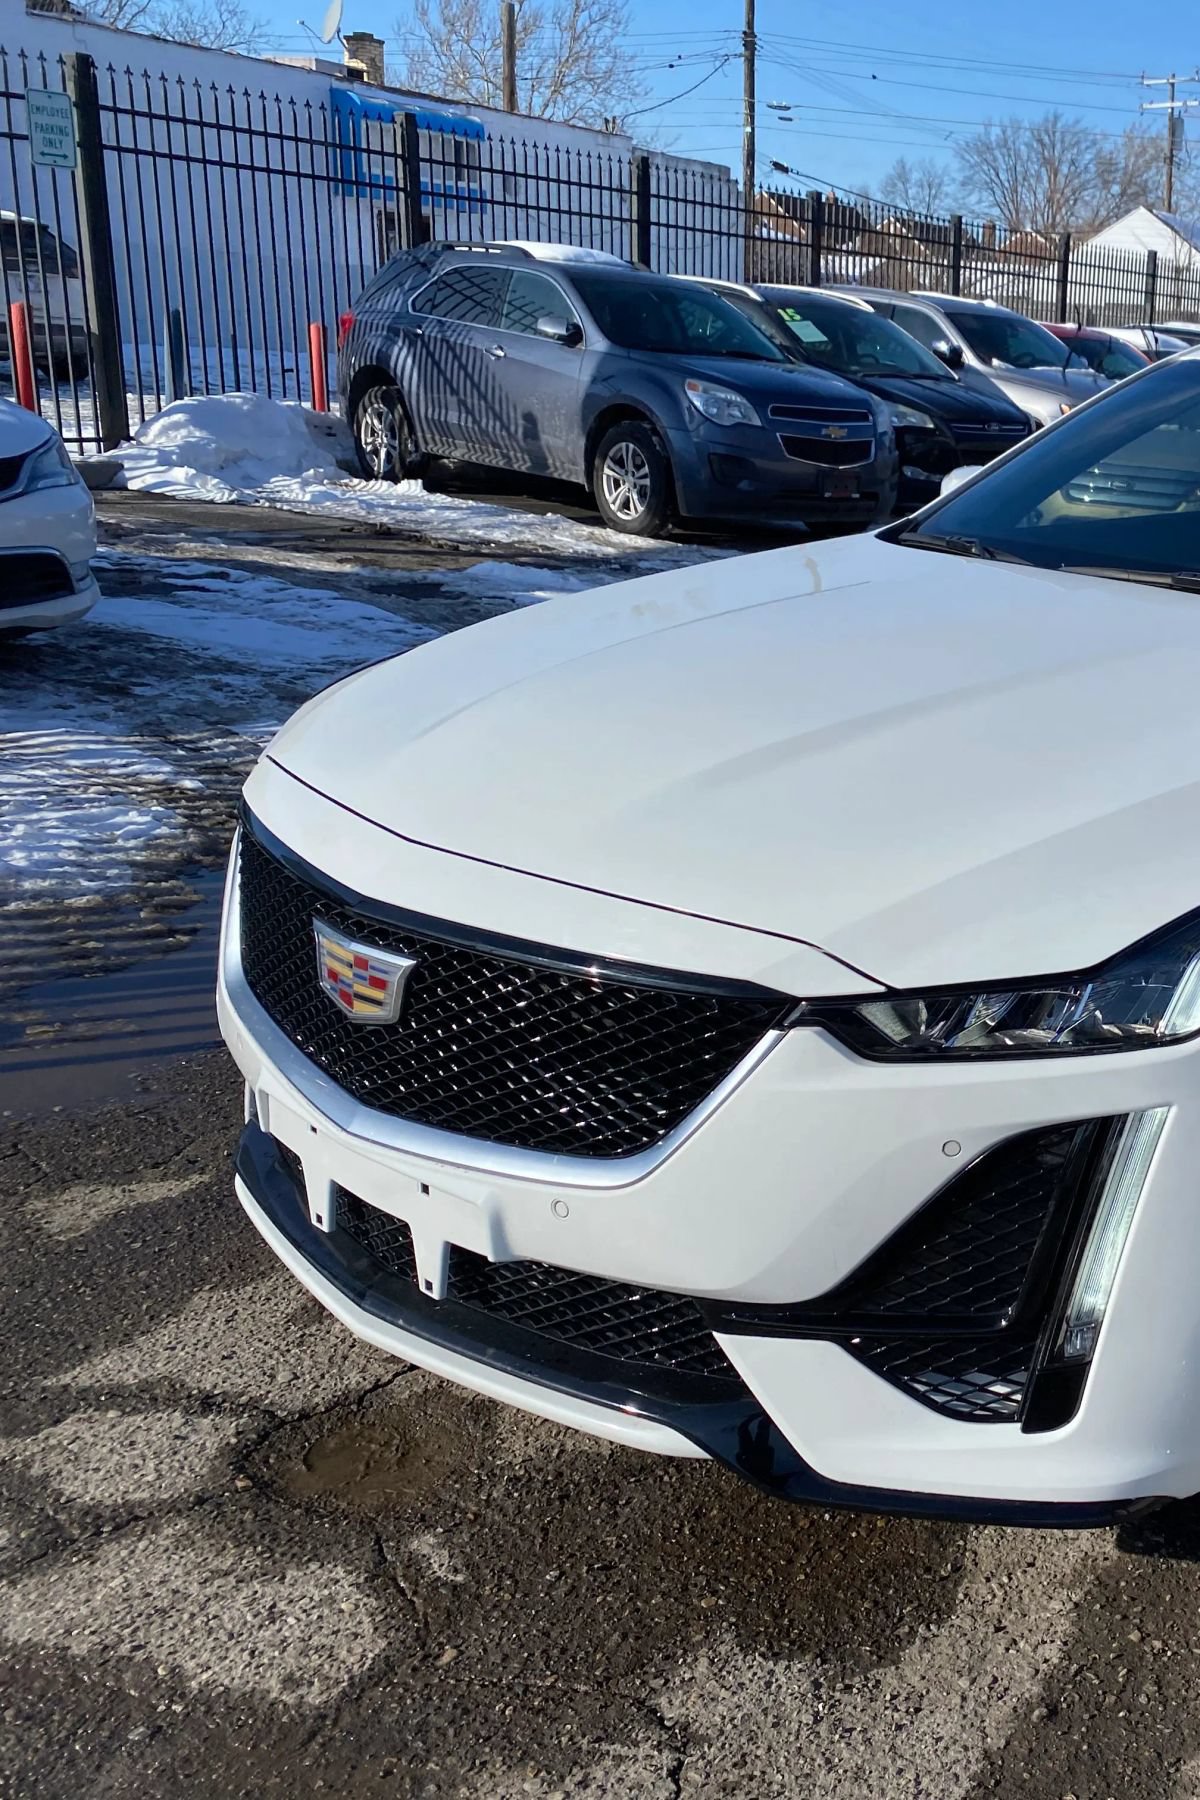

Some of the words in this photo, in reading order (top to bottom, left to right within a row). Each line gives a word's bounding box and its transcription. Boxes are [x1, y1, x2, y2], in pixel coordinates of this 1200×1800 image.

[30, 104, 70, 119] EMPLOYEE
[34, 122, 70, 137] PARKING
[42, 136, 64, 150] ONLY
[777, 308, 801, 321] 15
